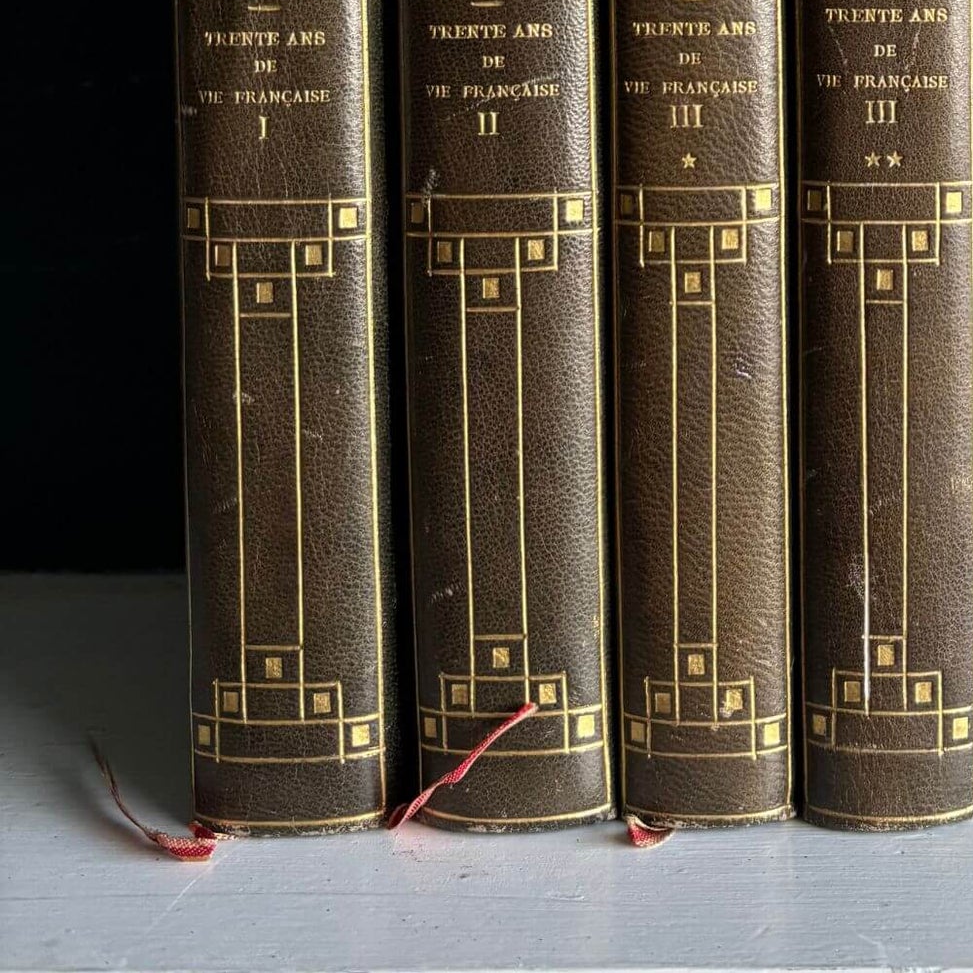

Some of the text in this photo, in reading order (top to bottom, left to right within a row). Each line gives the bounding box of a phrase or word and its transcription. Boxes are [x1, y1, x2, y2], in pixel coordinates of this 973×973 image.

[825, 7, 948, 23] TRENTE ANS
[429, 23, 553, 40] TRENTE ANS
[632, 21, 757, 37] TRENTE ANS
[205, 31, 326, 47] TRENTE ANS
[679, 52, 702, 65] DE
[874, 44, 897, 57] DE
[254, 60, 278, 73] DE
[482, 55, 505, 68] DE
[624, 80, 758, 98] VIE FRANÇAISE
[816, 74, 949, 93] VIE FRANÇAISE
[199, 89, 331, 107] VIE FRANÇAISE
[426, 84, 560, 101] VIE FRANÇAISE
[670, 104, 704, 129] III
[865, 100, 899, 124] III
[259, 116, 269, 140] I
[478, 111, 500, 136] II
